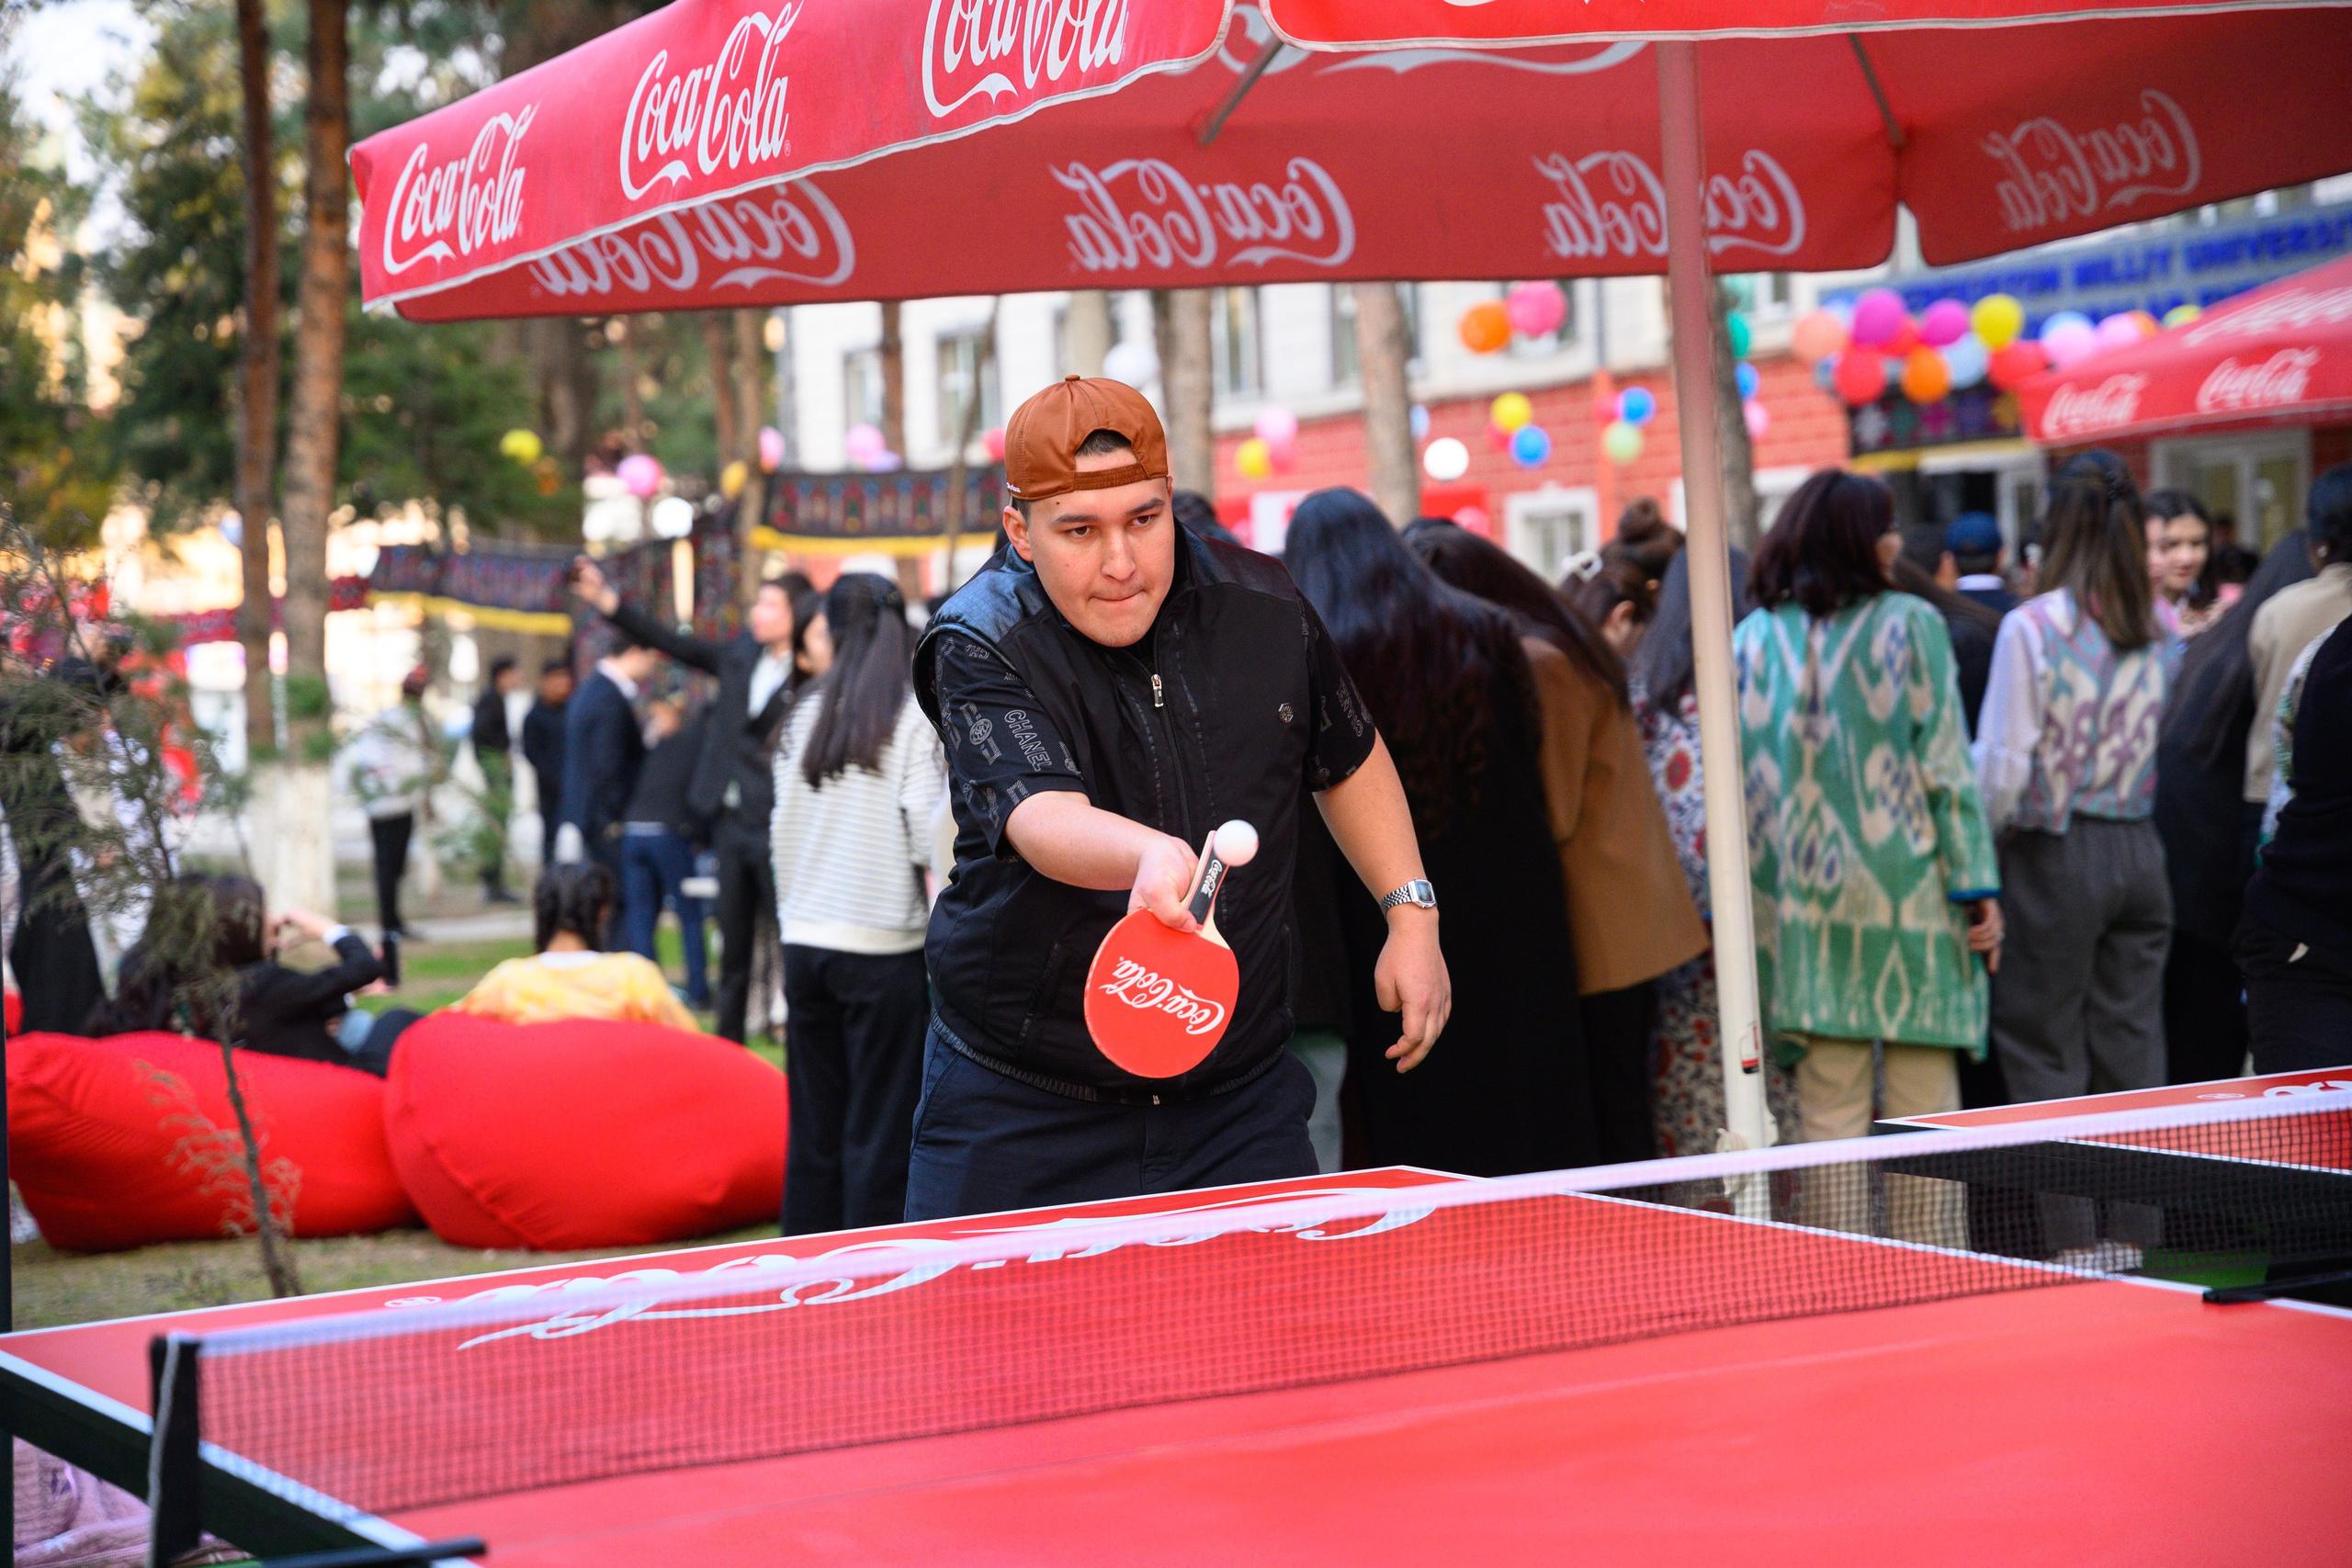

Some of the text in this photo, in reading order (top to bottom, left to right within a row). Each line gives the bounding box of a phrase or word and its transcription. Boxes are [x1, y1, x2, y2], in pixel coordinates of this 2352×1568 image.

[620, 0, 804, 201] Coca-Cola
[922, 0, 1129, 118] CocaCola
[383, 101, 540, 275] Coca-Cola
[1004, 709, 1052, 773] CHANEL
[1200, 859, 1223, 898] Coca-Cola
[1098, 959, 1225, 1035] Coca-Cola
